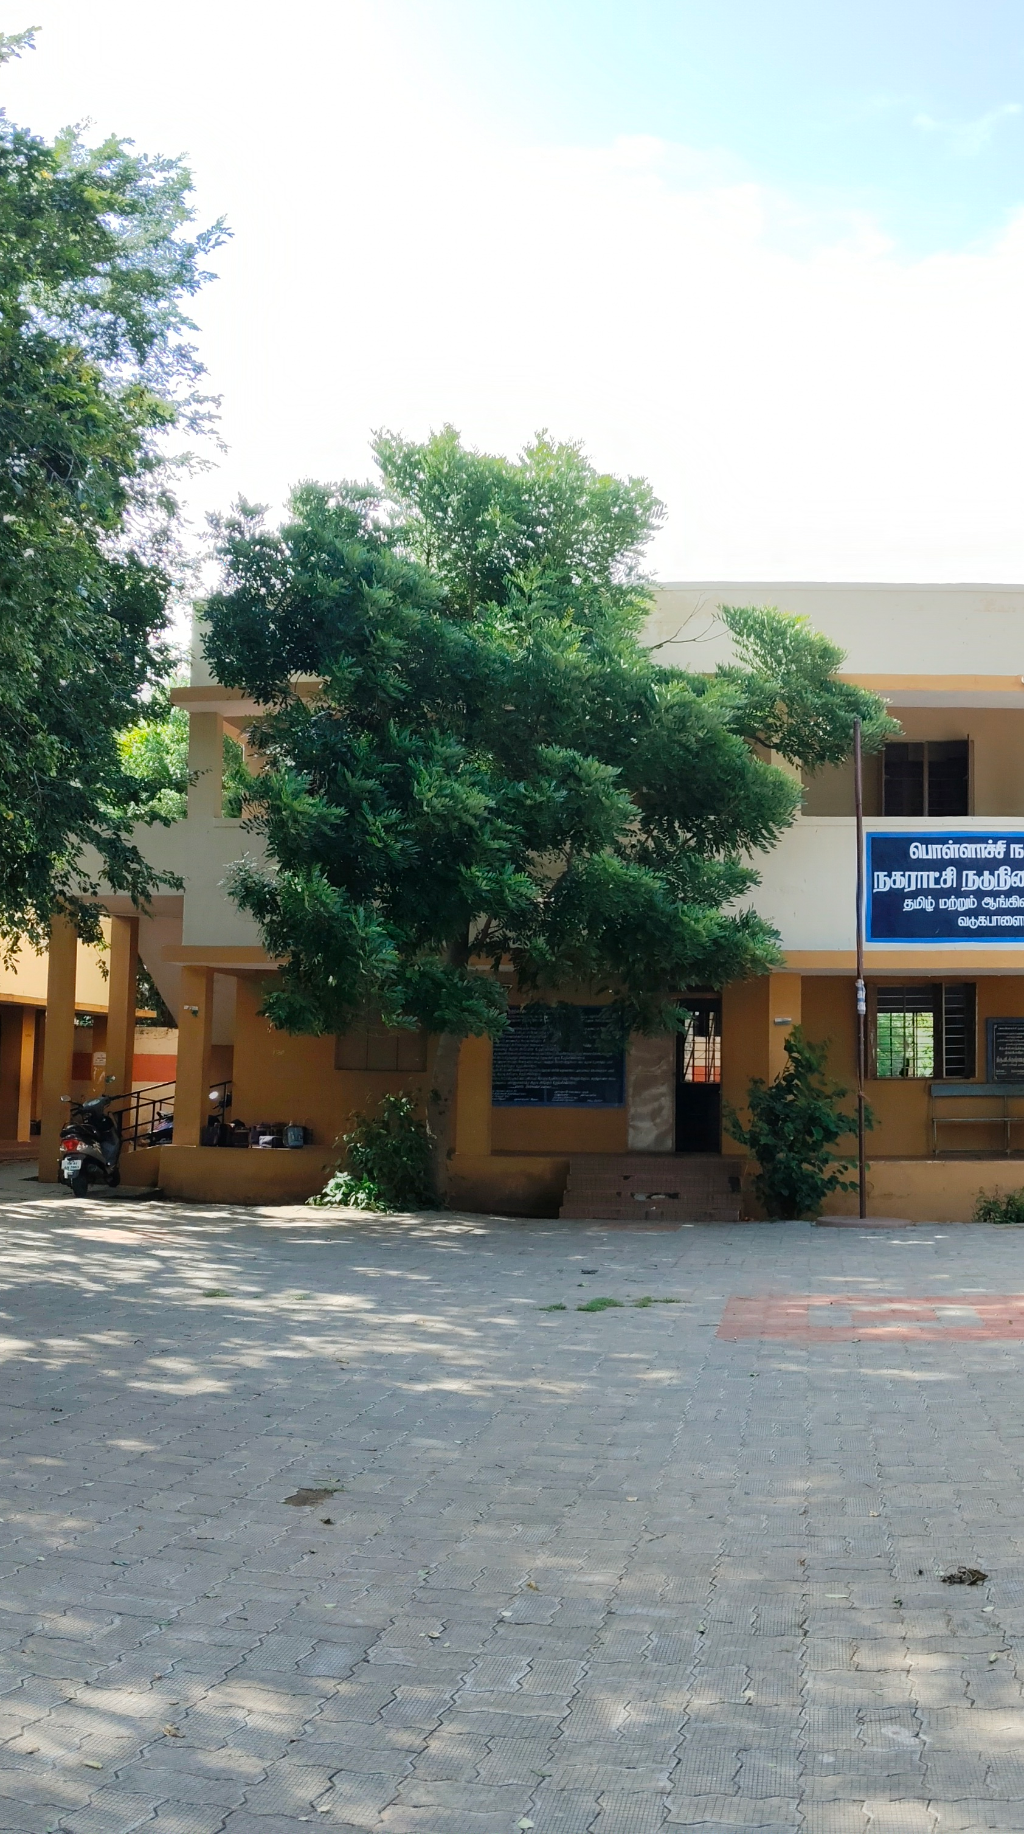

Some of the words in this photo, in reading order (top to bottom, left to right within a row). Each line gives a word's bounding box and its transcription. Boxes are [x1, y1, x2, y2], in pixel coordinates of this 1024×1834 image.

[909, 839, 1006, 860] பொள்ளாச்சி
[873, 867, 956, 893] நகராட்சி
[903, 896, 935, 912] தமிழ்
[938, 895, 977, 912] மற்றும்
